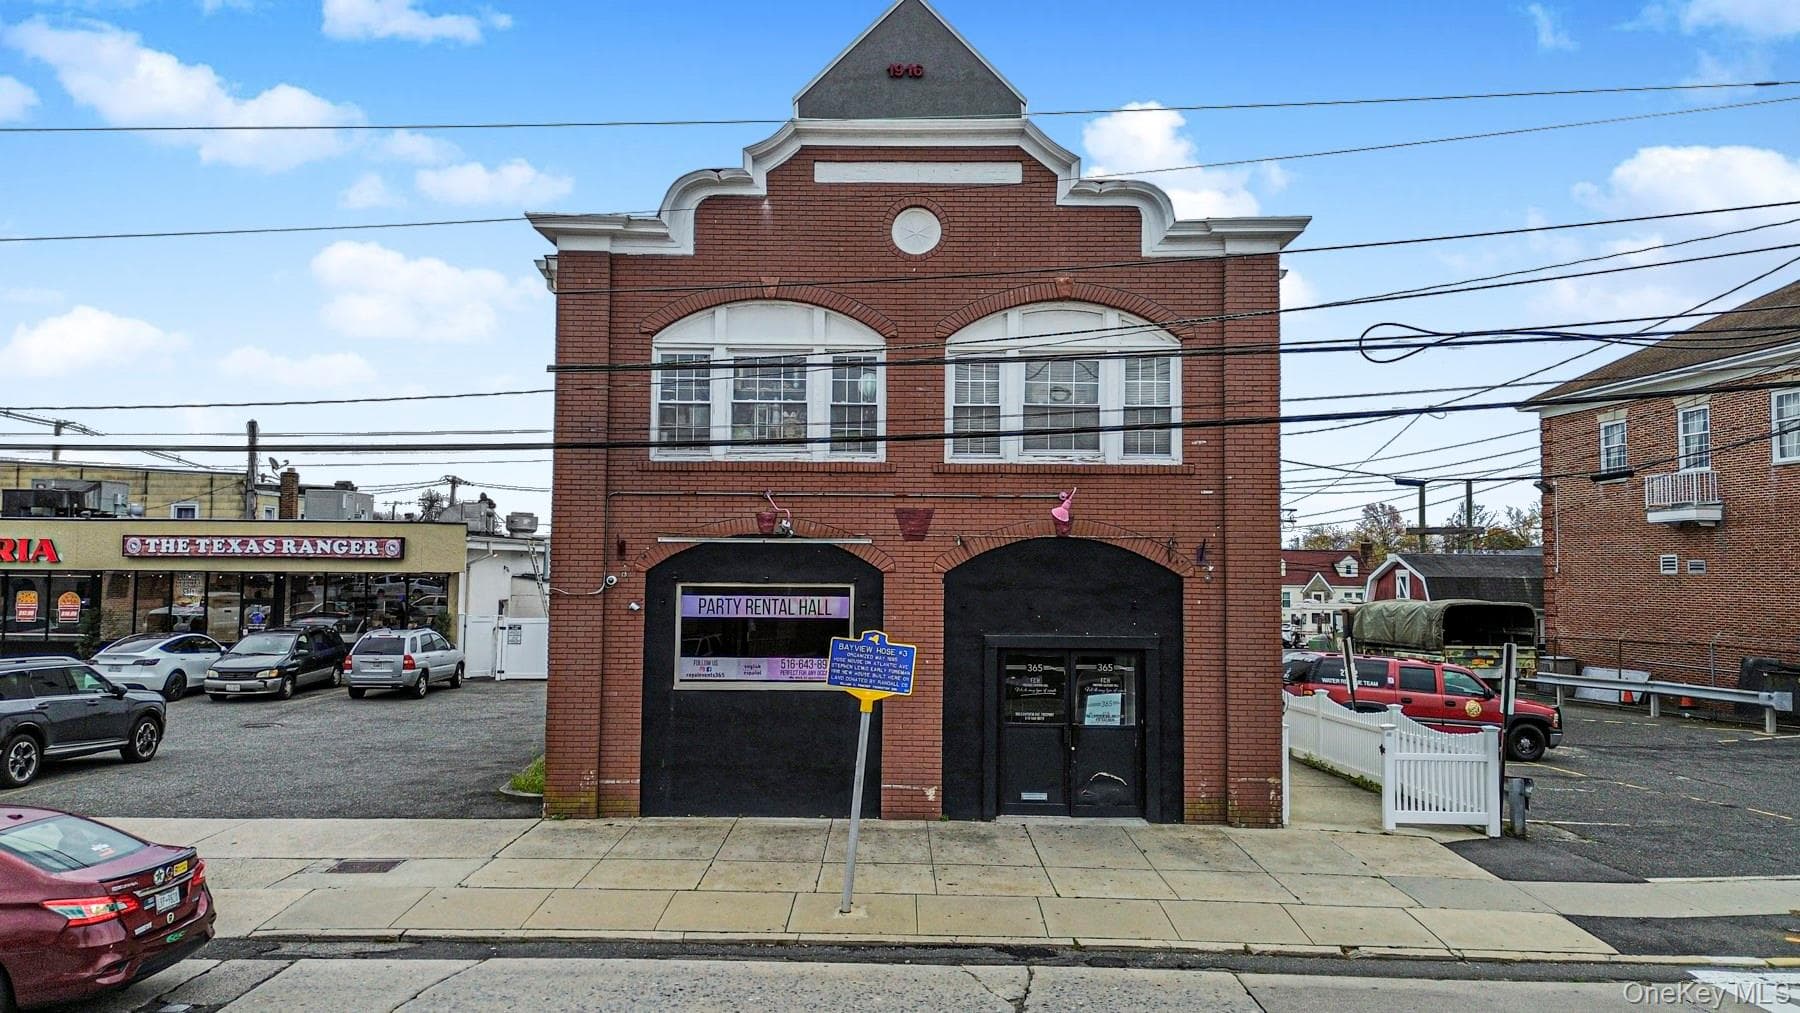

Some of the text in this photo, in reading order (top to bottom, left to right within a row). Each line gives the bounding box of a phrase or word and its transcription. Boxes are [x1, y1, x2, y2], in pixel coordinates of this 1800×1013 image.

[889, 63, 924, 79] 1916
[146, 538, 379, 556] THE TEXAS RANGER
[698, 598, 832, 616] PARTY RENTAL HALL
[838, 643, 873, 653] BAYVIEW
[876, 647, 896, 656] HOSE
[780, 659, 827, 669] 516-643-89
[1027, 663, 1043, 672] 365
[1097, 663, 1114, 672] 365
